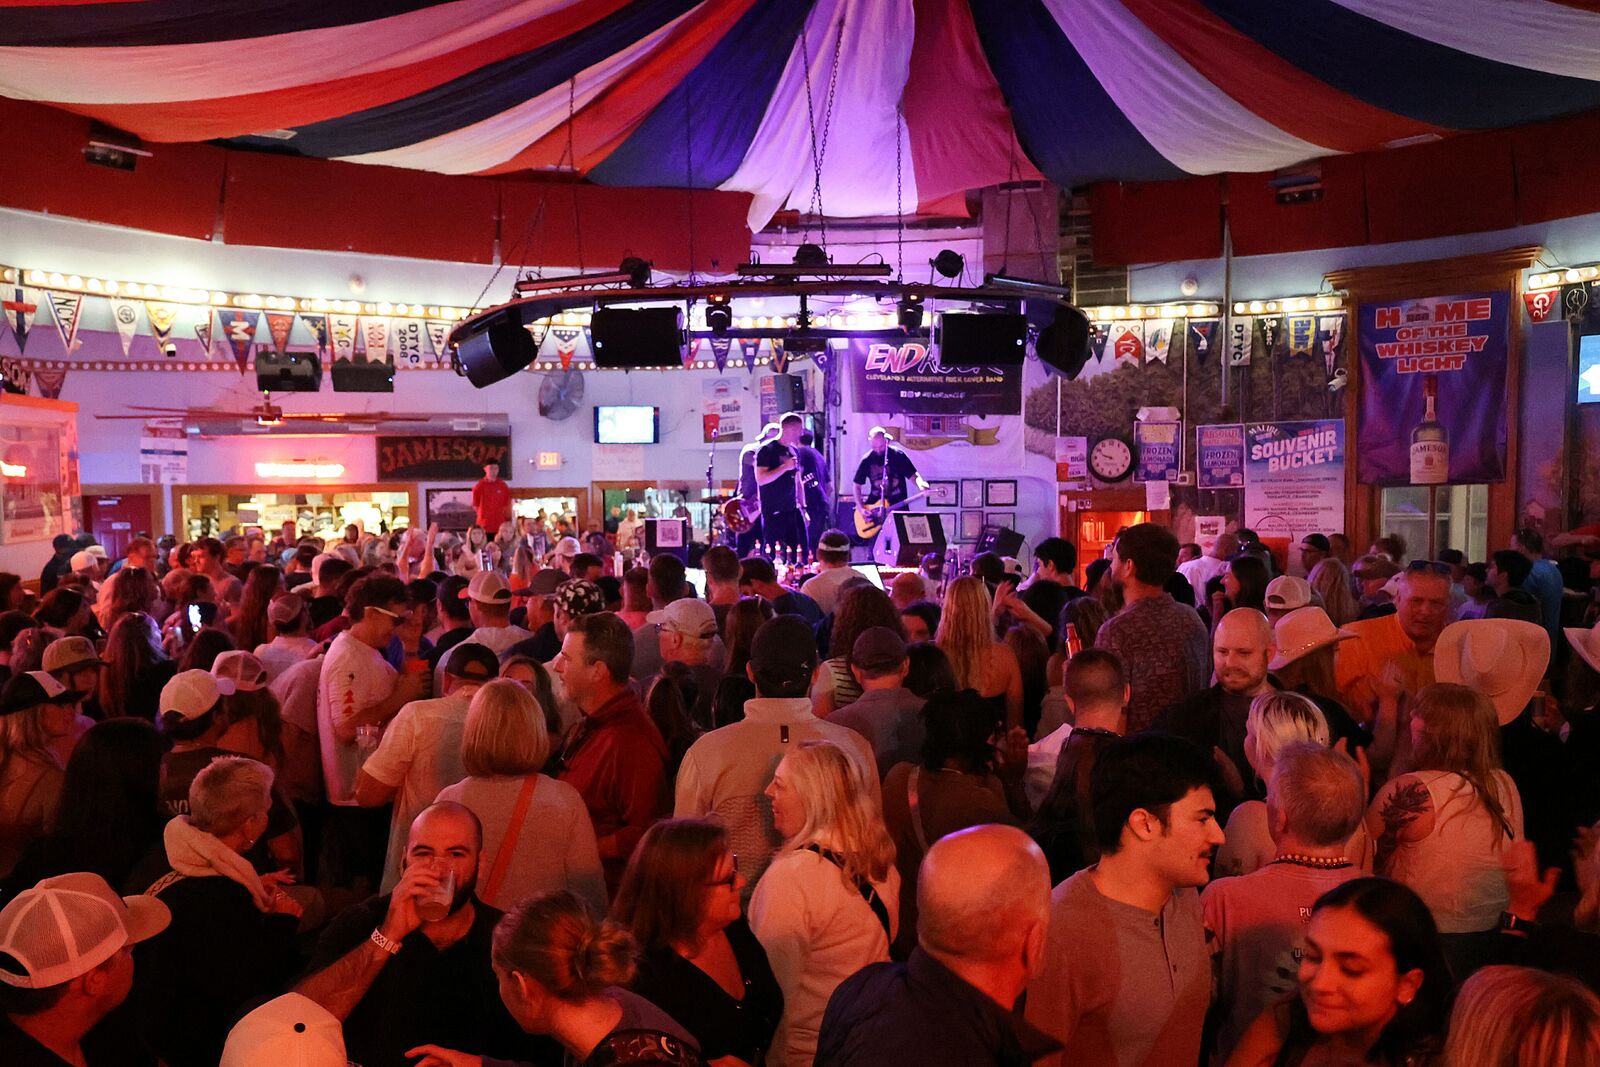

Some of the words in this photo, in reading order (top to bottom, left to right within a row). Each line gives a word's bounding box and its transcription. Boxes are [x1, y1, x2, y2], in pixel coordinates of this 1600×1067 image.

[399, 329, 409, 359] 2008
[409, 324, 420, 364] DTYC
[1234, 324, 1245, 362] DTYC
[1396, 327, 1425, 342] OF
[1426, 323, 1468, 338] THE
[1375, 335, 1489, 360] WHISKEY
[1397, 354, 1467, 374] LIGHT
[381, 438, 507, 472] JAMESON
[1142, 446, 1174, 455] FROZEN
[1206, 449, 1238, 460] FROZEN
[1251, 430, 1336, 460] SOUVENIR
[1268, 446, 1338, 473] BUCKET
